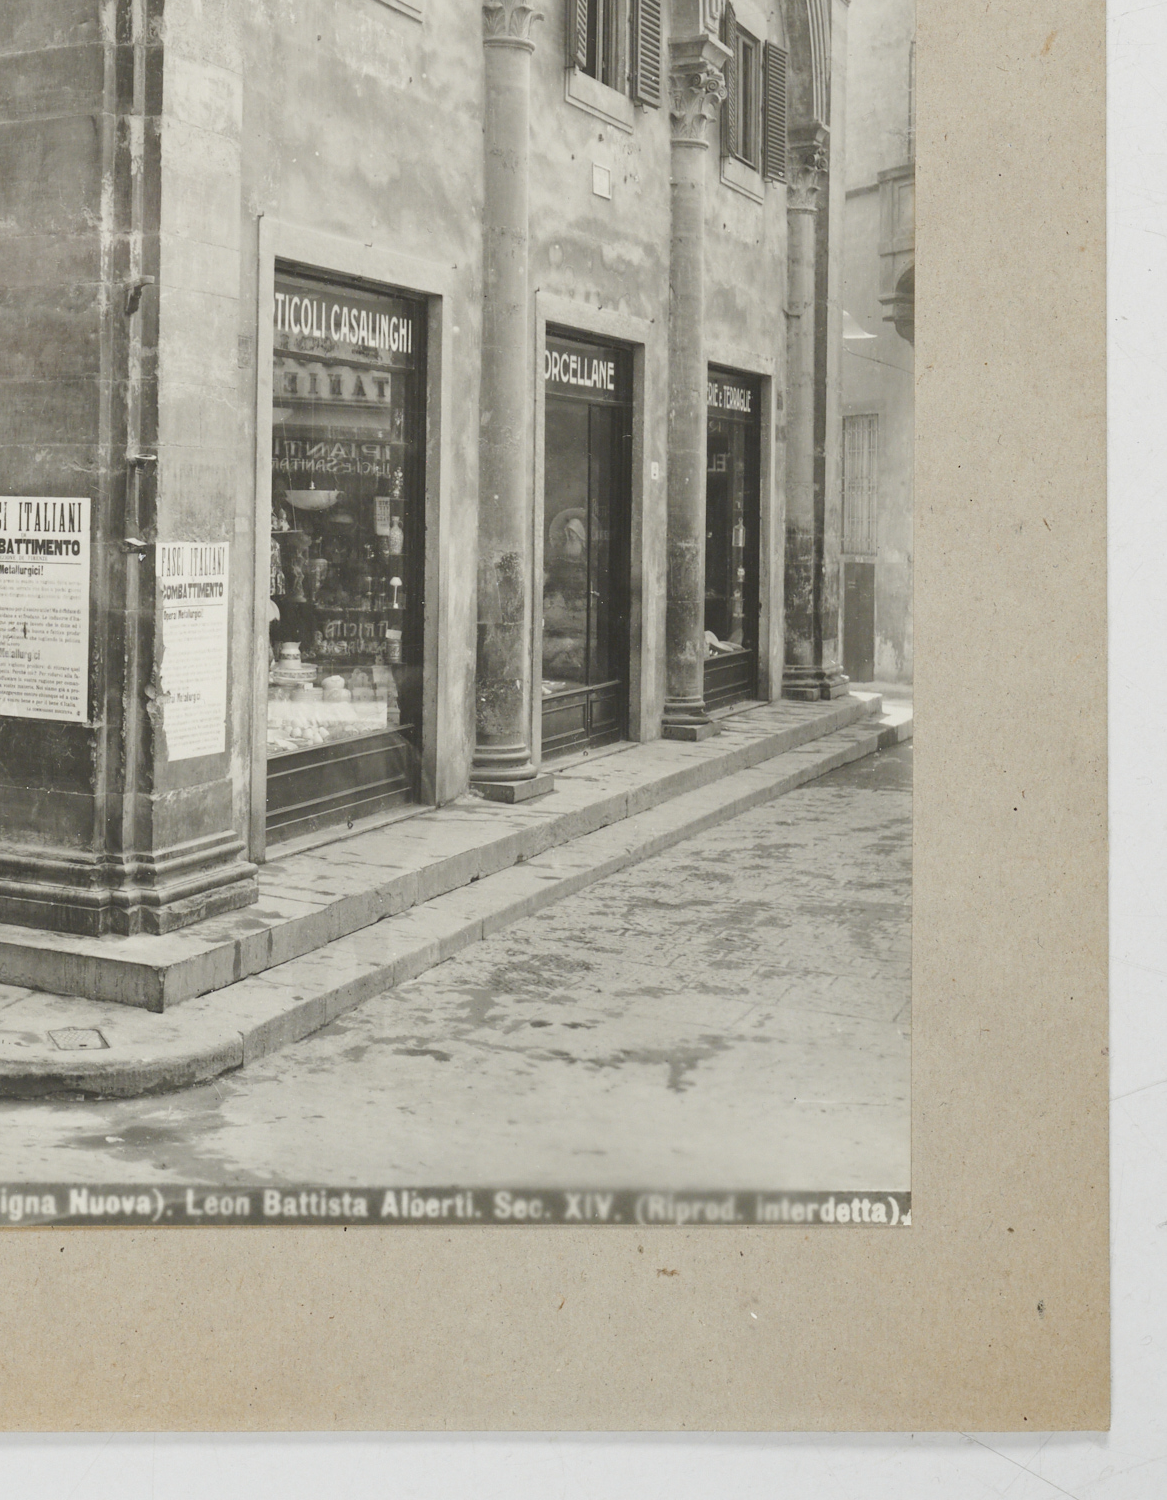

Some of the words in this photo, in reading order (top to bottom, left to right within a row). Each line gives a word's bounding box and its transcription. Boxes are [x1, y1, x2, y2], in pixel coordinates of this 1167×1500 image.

[273, 292, 326, 339] TICOLI
[330, 304, 412, 354] CASALINGHI
[544, 350, 615, 391] ORCELLANE
[707, 381, 718, 408] RIE
[18, 502, 82, 533] ITALIANI
[161, 547, 184, 577] FASCI
[189, 547, 225, 577] ITALIANI
